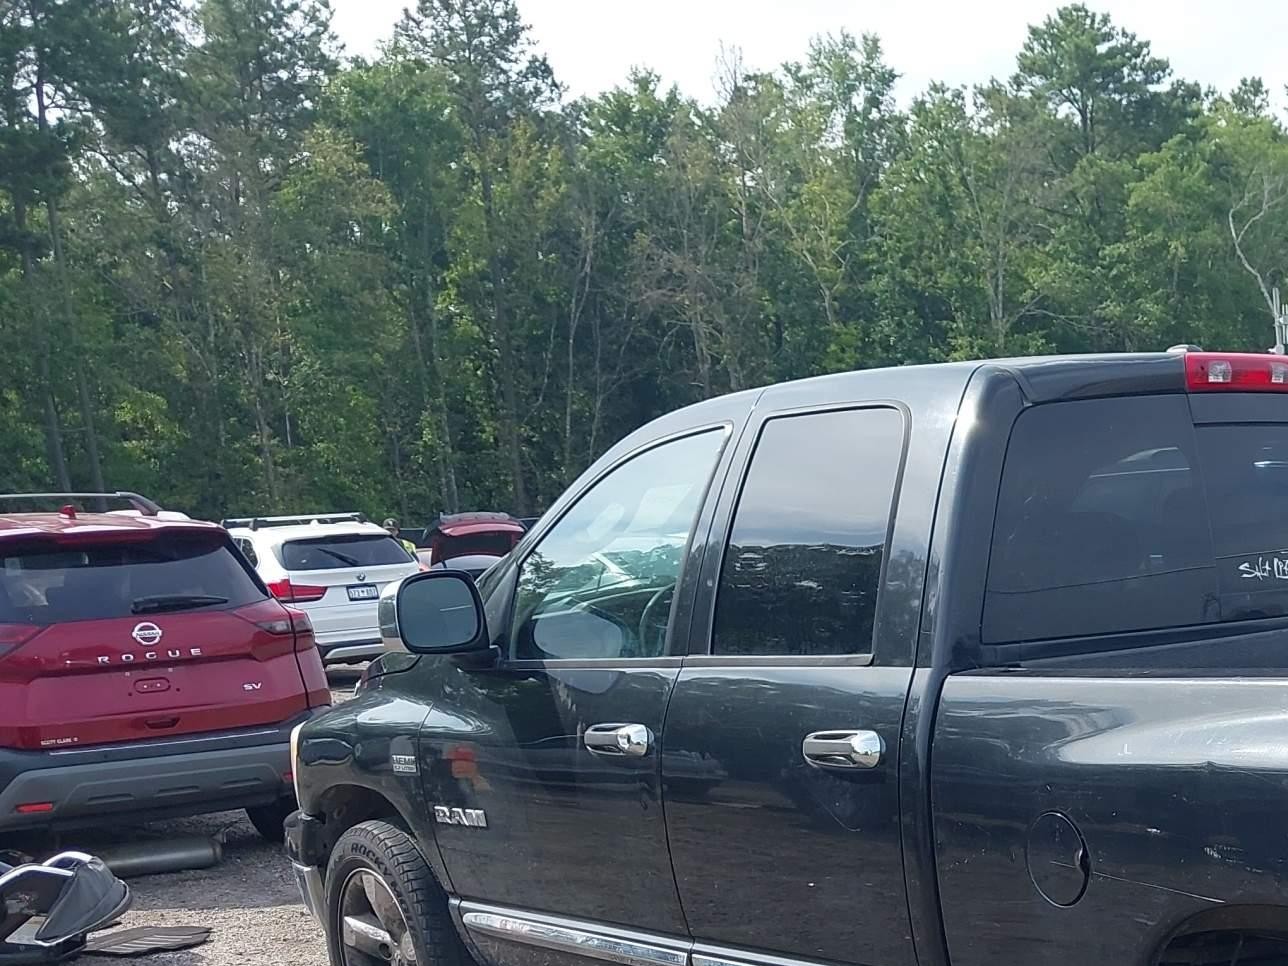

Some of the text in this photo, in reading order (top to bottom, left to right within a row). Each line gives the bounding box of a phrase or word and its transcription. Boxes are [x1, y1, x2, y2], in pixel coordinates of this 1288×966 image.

[97, 648, 202, 664] ROGUE
[243, 682, 262, 691] SV
[434, 806, 488, 827] RAM
[351, 842, 392, 876] ROCKY
